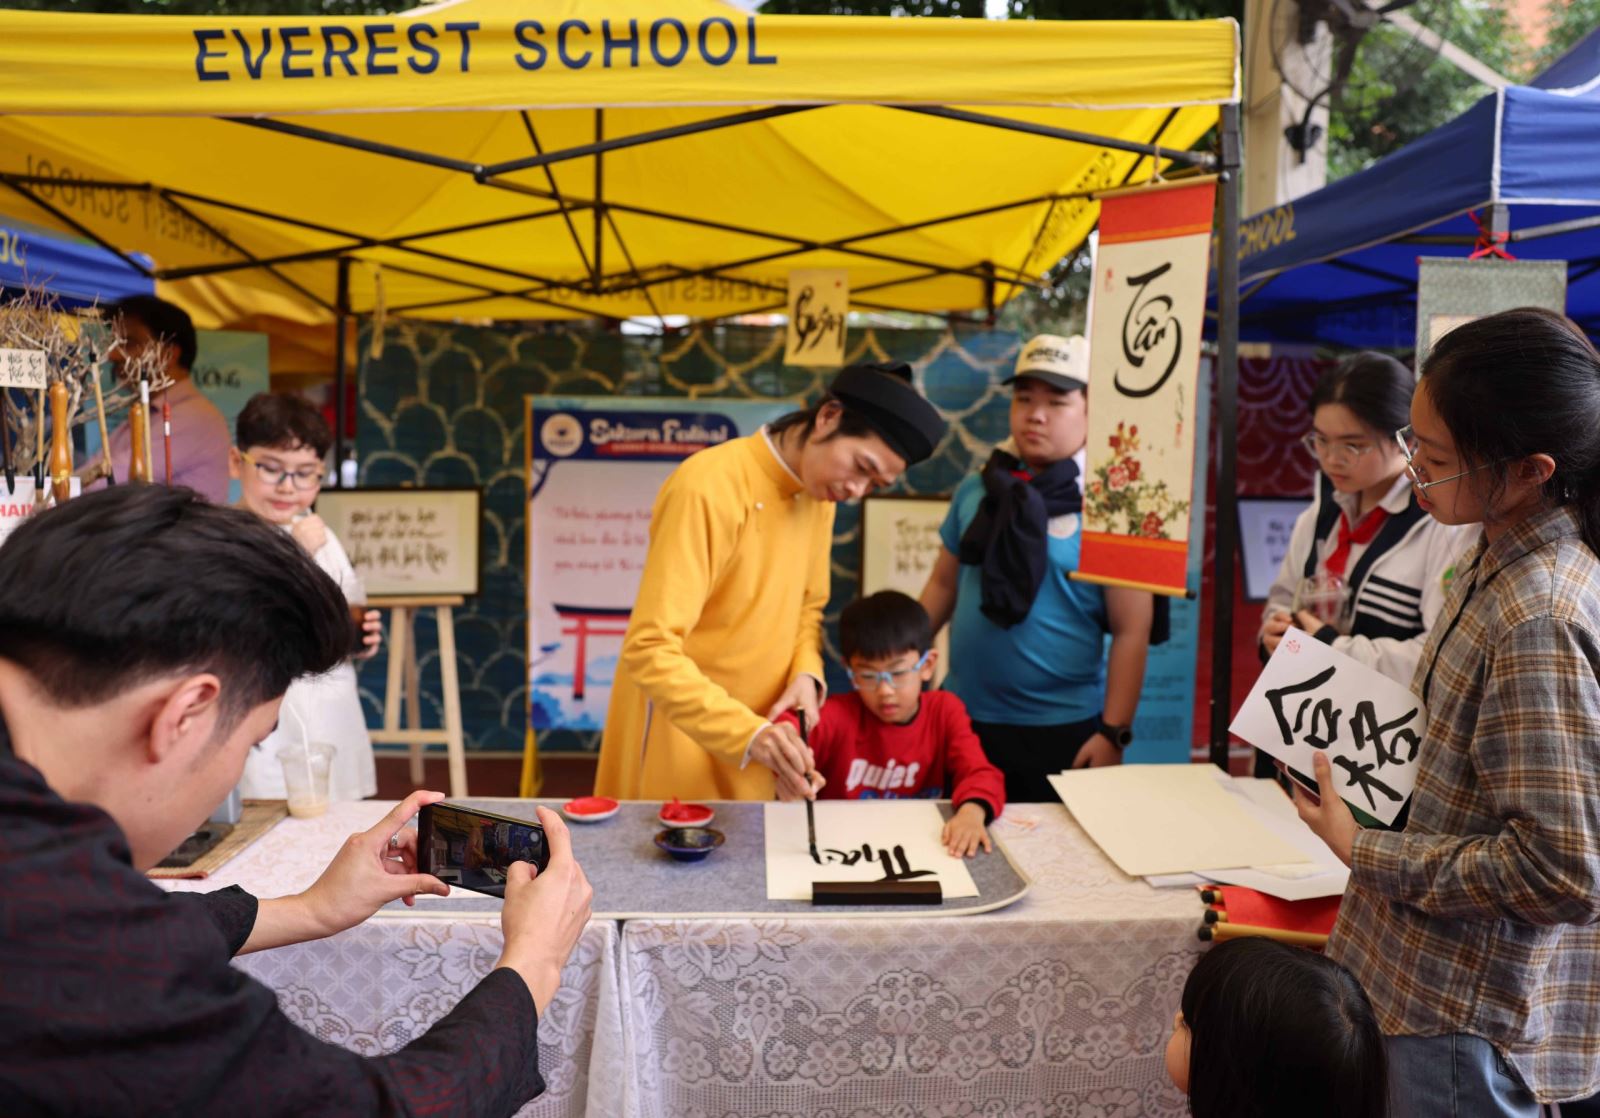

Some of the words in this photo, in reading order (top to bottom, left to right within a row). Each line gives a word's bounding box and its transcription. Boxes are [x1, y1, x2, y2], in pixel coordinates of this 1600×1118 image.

[193, 21, 480, 82] EVEREST
[513, 16, 778, 71] SCHOOL
[845, 758, 920, 792] Quiet
